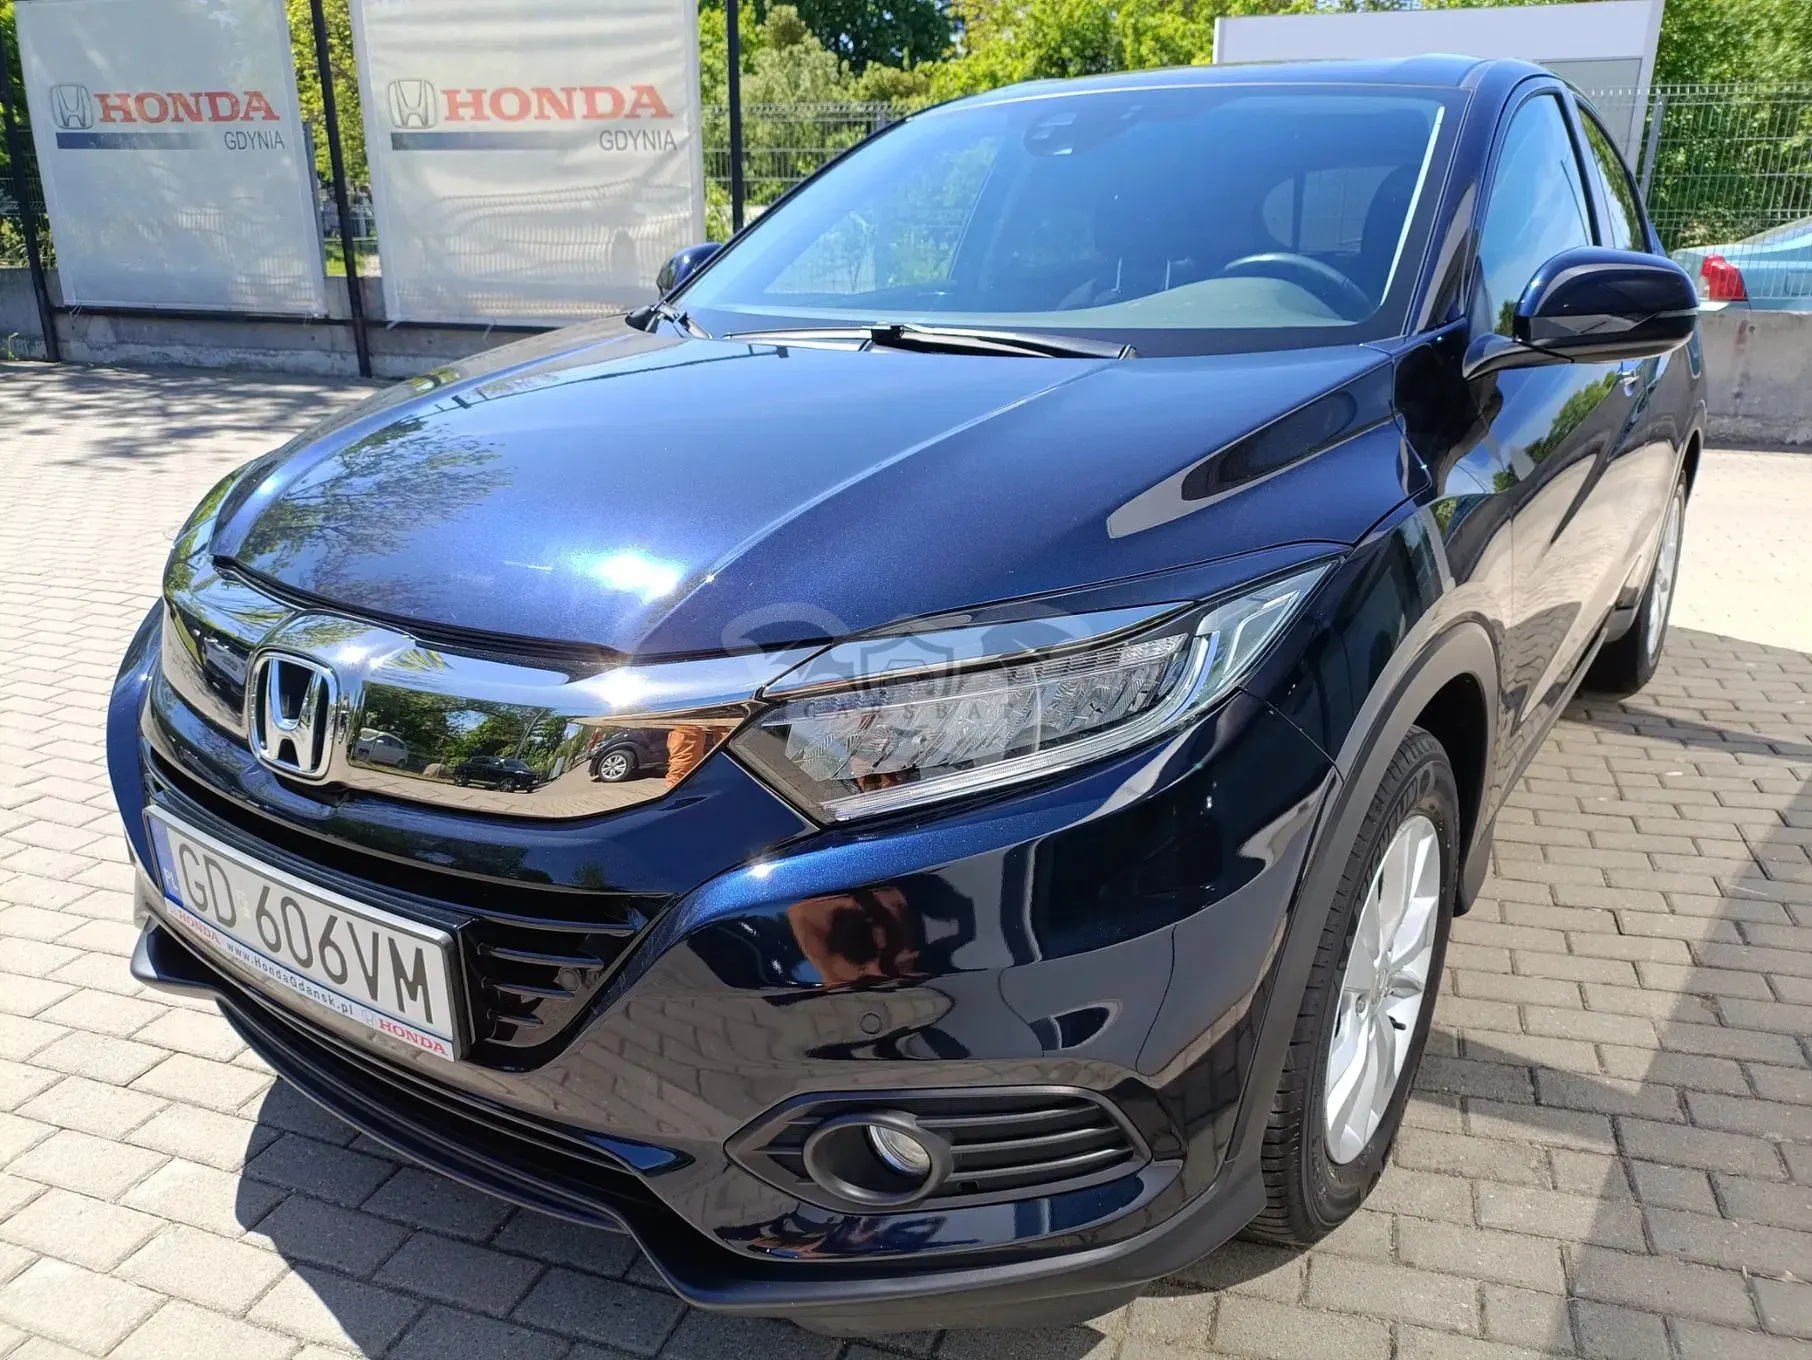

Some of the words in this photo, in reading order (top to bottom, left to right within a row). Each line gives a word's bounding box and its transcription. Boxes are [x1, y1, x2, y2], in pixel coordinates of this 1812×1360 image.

[94, 90, 281, 124] HONDA
[440, 84, 674, 122] HONDA
[224, 130, 286, 151] GDYNIA
[599, 129, 678, 151] GDYNIA
[162, 866, 179, 892] PL
[176, 909, 221, 946] HONDA
[178, 843, 237, 929] GD
[255, 885, 434, 1026] 606VM
[226, 942, 354, 1016] www.HondaGdansk.pl
[378, 1018, 449, 1057] HONDA
